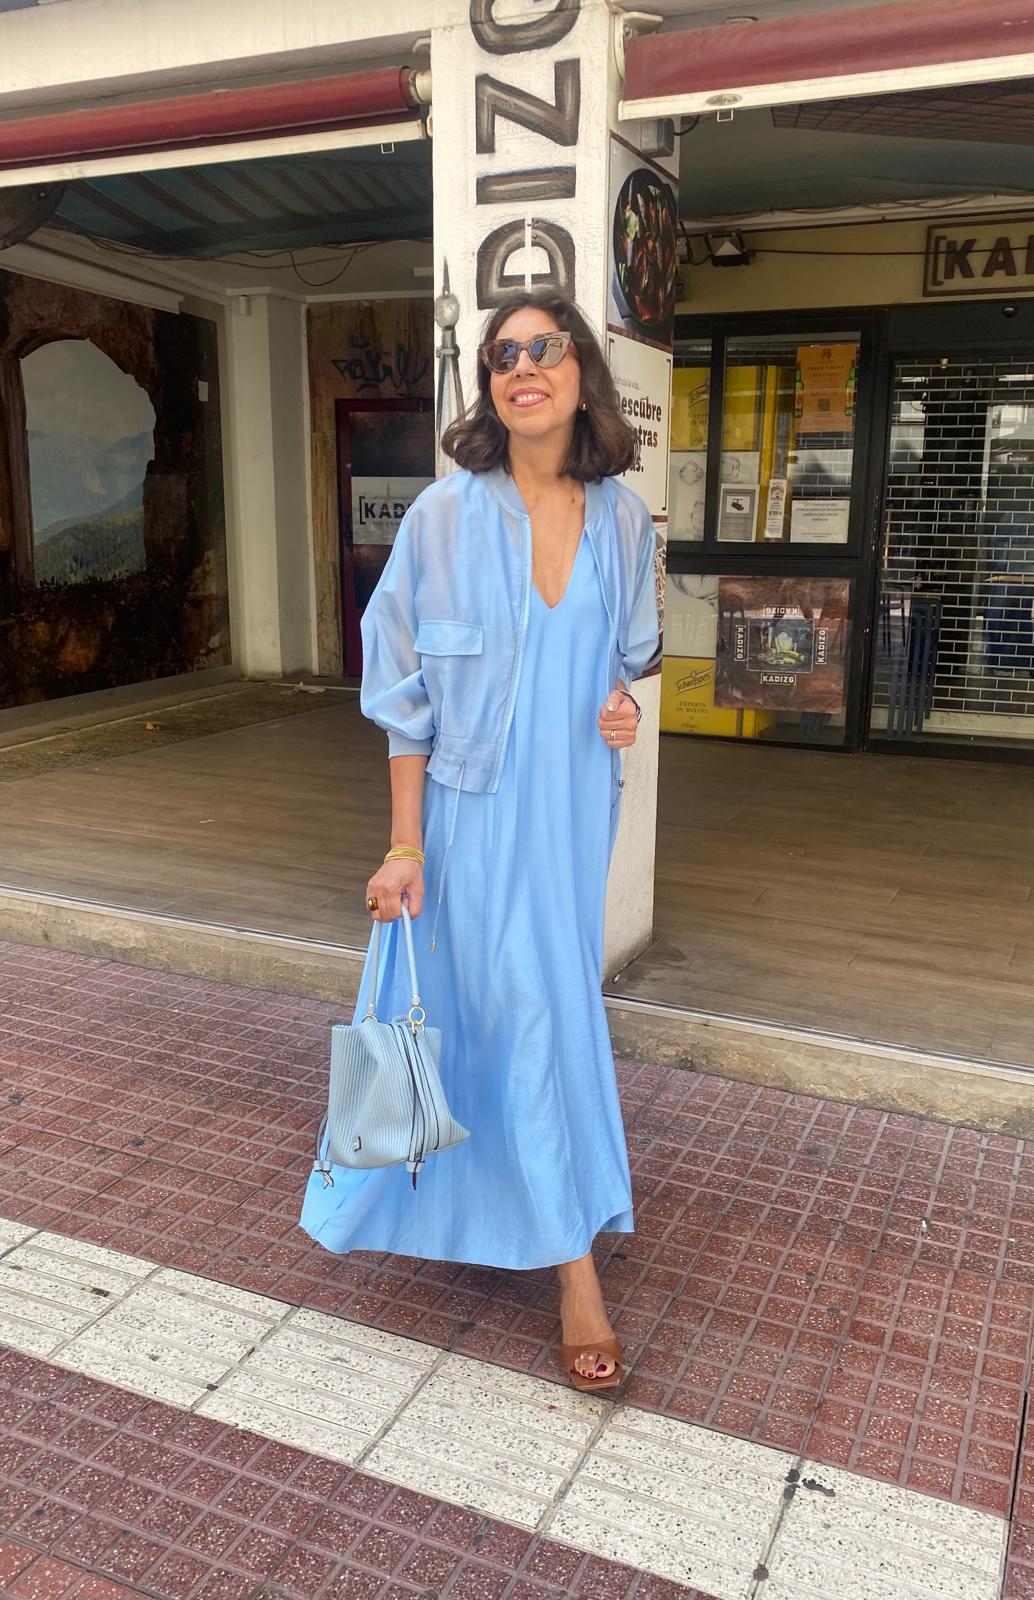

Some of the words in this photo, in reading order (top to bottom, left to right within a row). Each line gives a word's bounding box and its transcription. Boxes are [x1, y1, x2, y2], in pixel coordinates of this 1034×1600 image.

[619, 395, 662, 422] escubre
[736, 627, 744, 659] KADIZG
[817, 629, 826, 663] KADIZG
[675, 673, 711, 692] Schweppes
[762, 675, 794, 683] KADIZG
